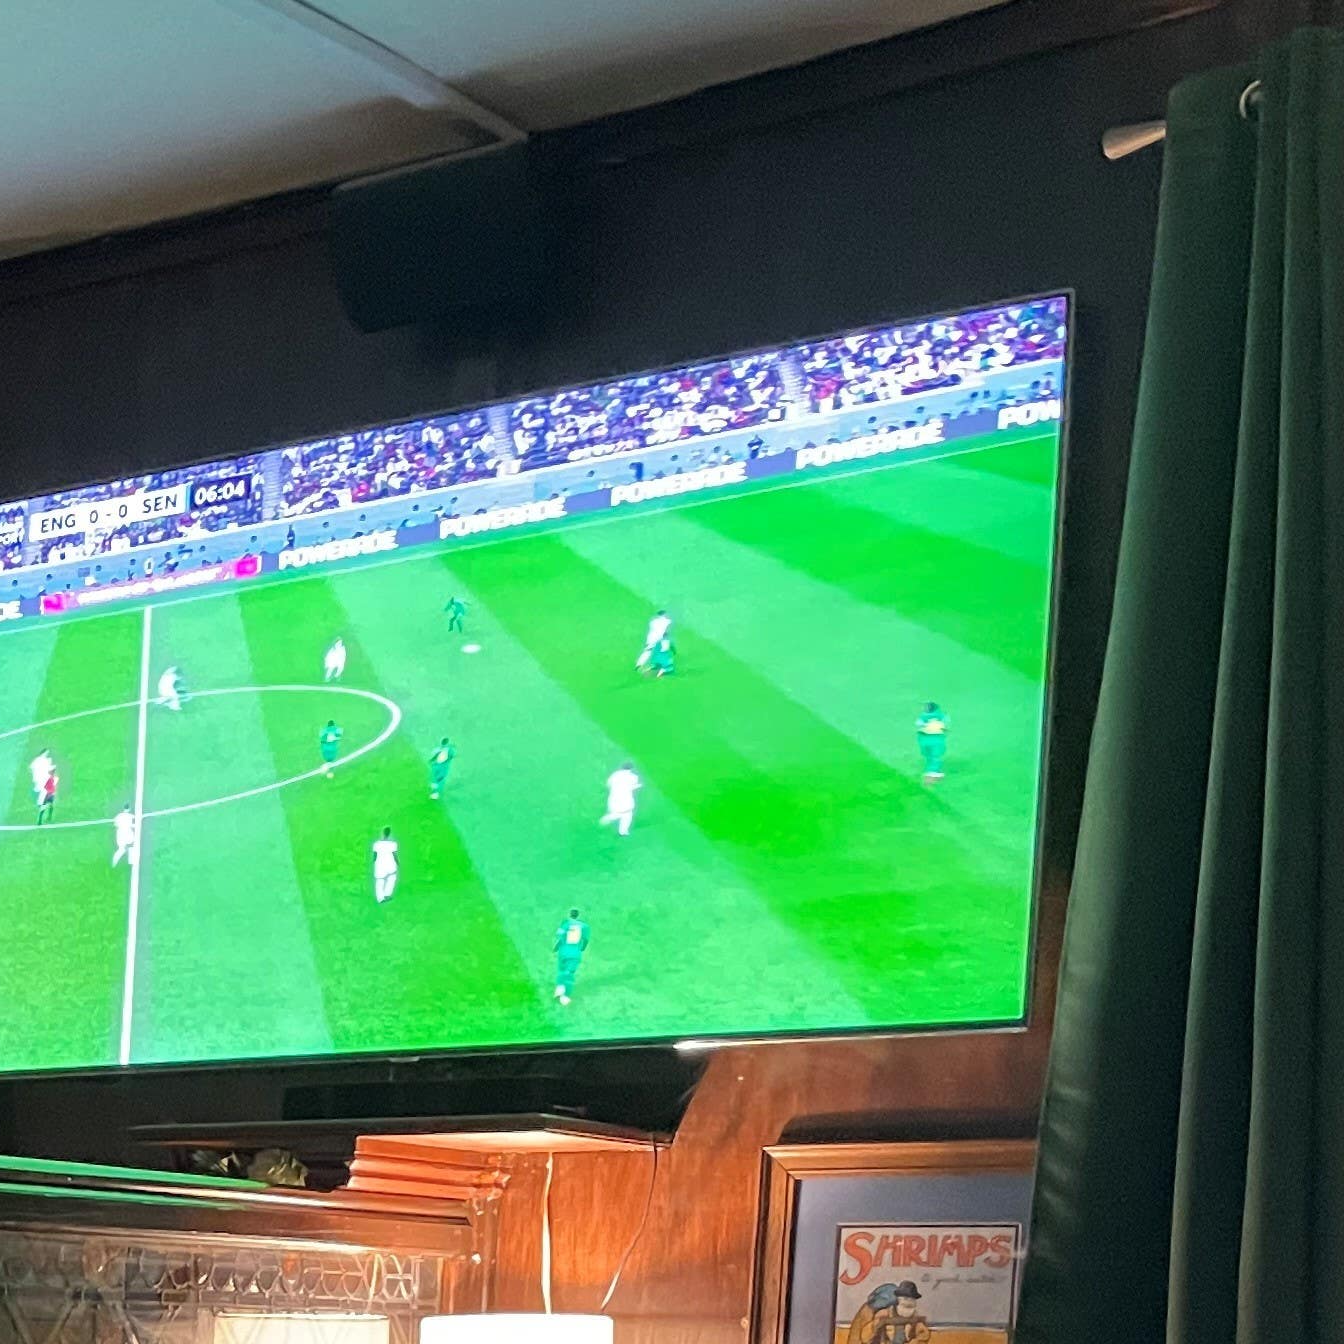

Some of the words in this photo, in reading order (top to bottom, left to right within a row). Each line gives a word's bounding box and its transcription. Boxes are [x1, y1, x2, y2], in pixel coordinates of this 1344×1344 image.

[795, 420, 946, 470] POWERADE
[41, 514, 76, 533] ENG
[89, 510, 98, 523] 0
[118, 504, 128, 518] 0
[142, 494, 179, 513] SEN
[194, 480, 245, 505] 06:04
[611, 461, 748, 507] POWERADE
[440, 496, 567, 539] POWERADE
[278, 530, 399, 570] POWERADE
[840, 1231, 1013, 1286] SHRIMPS
